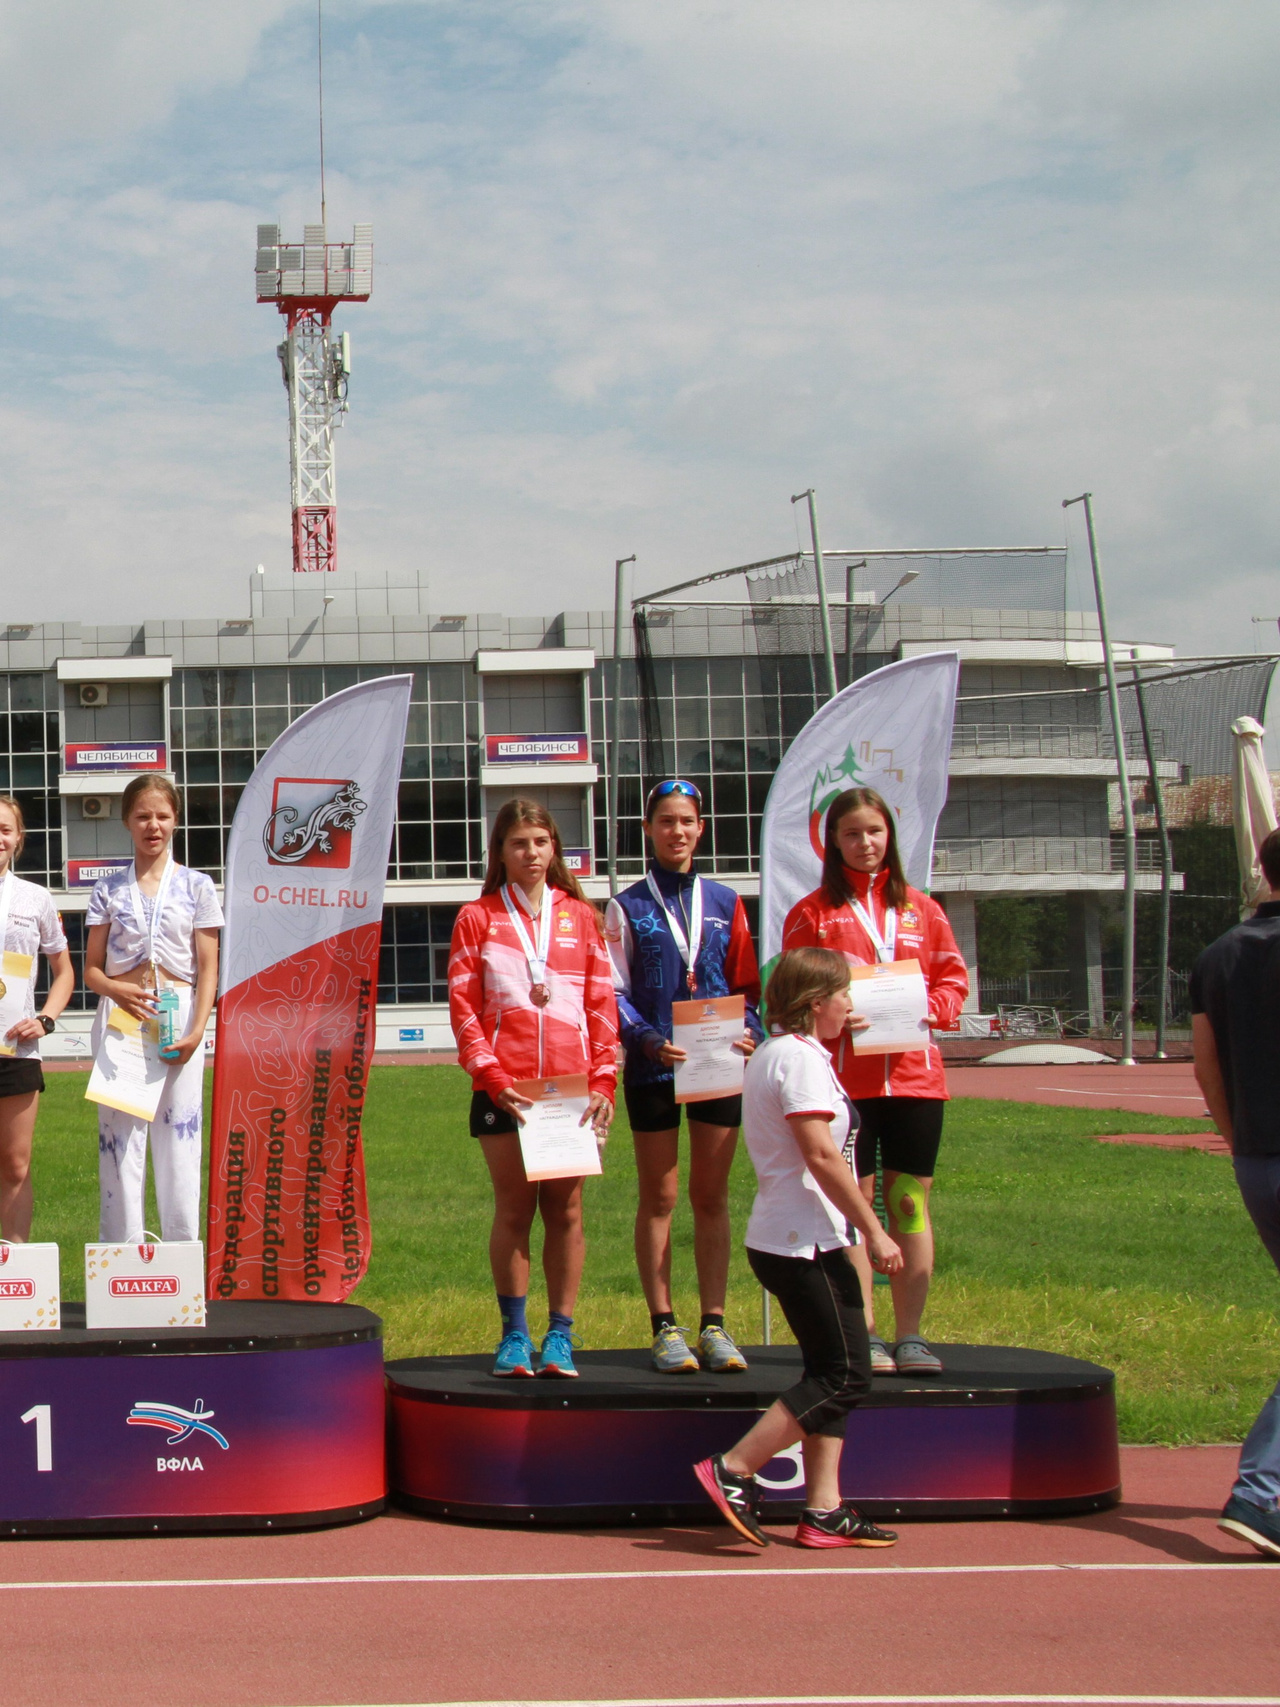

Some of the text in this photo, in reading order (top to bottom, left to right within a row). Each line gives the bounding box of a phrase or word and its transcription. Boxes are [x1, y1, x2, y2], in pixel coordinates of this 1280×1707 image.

[78, 751, 155, 762] ЧЕЛЯБИНСК
[500, 742, 577, 753] ЧЕЛЯБИНСК
[253, 885, 368, 909] O-CHEL.RU
[344, 978, 372, 1096] области
[303, 1048, 333, 1296] ориентирования
[216, 1129, 246, 1297] Федерация
[261, 1108, 287, 1297] спортивного
[115, 1281, 173, 1294] MAKFA
[19, 1404, 54, 1472] 1
[156, 1457, 205, 1473] ВФЛА
